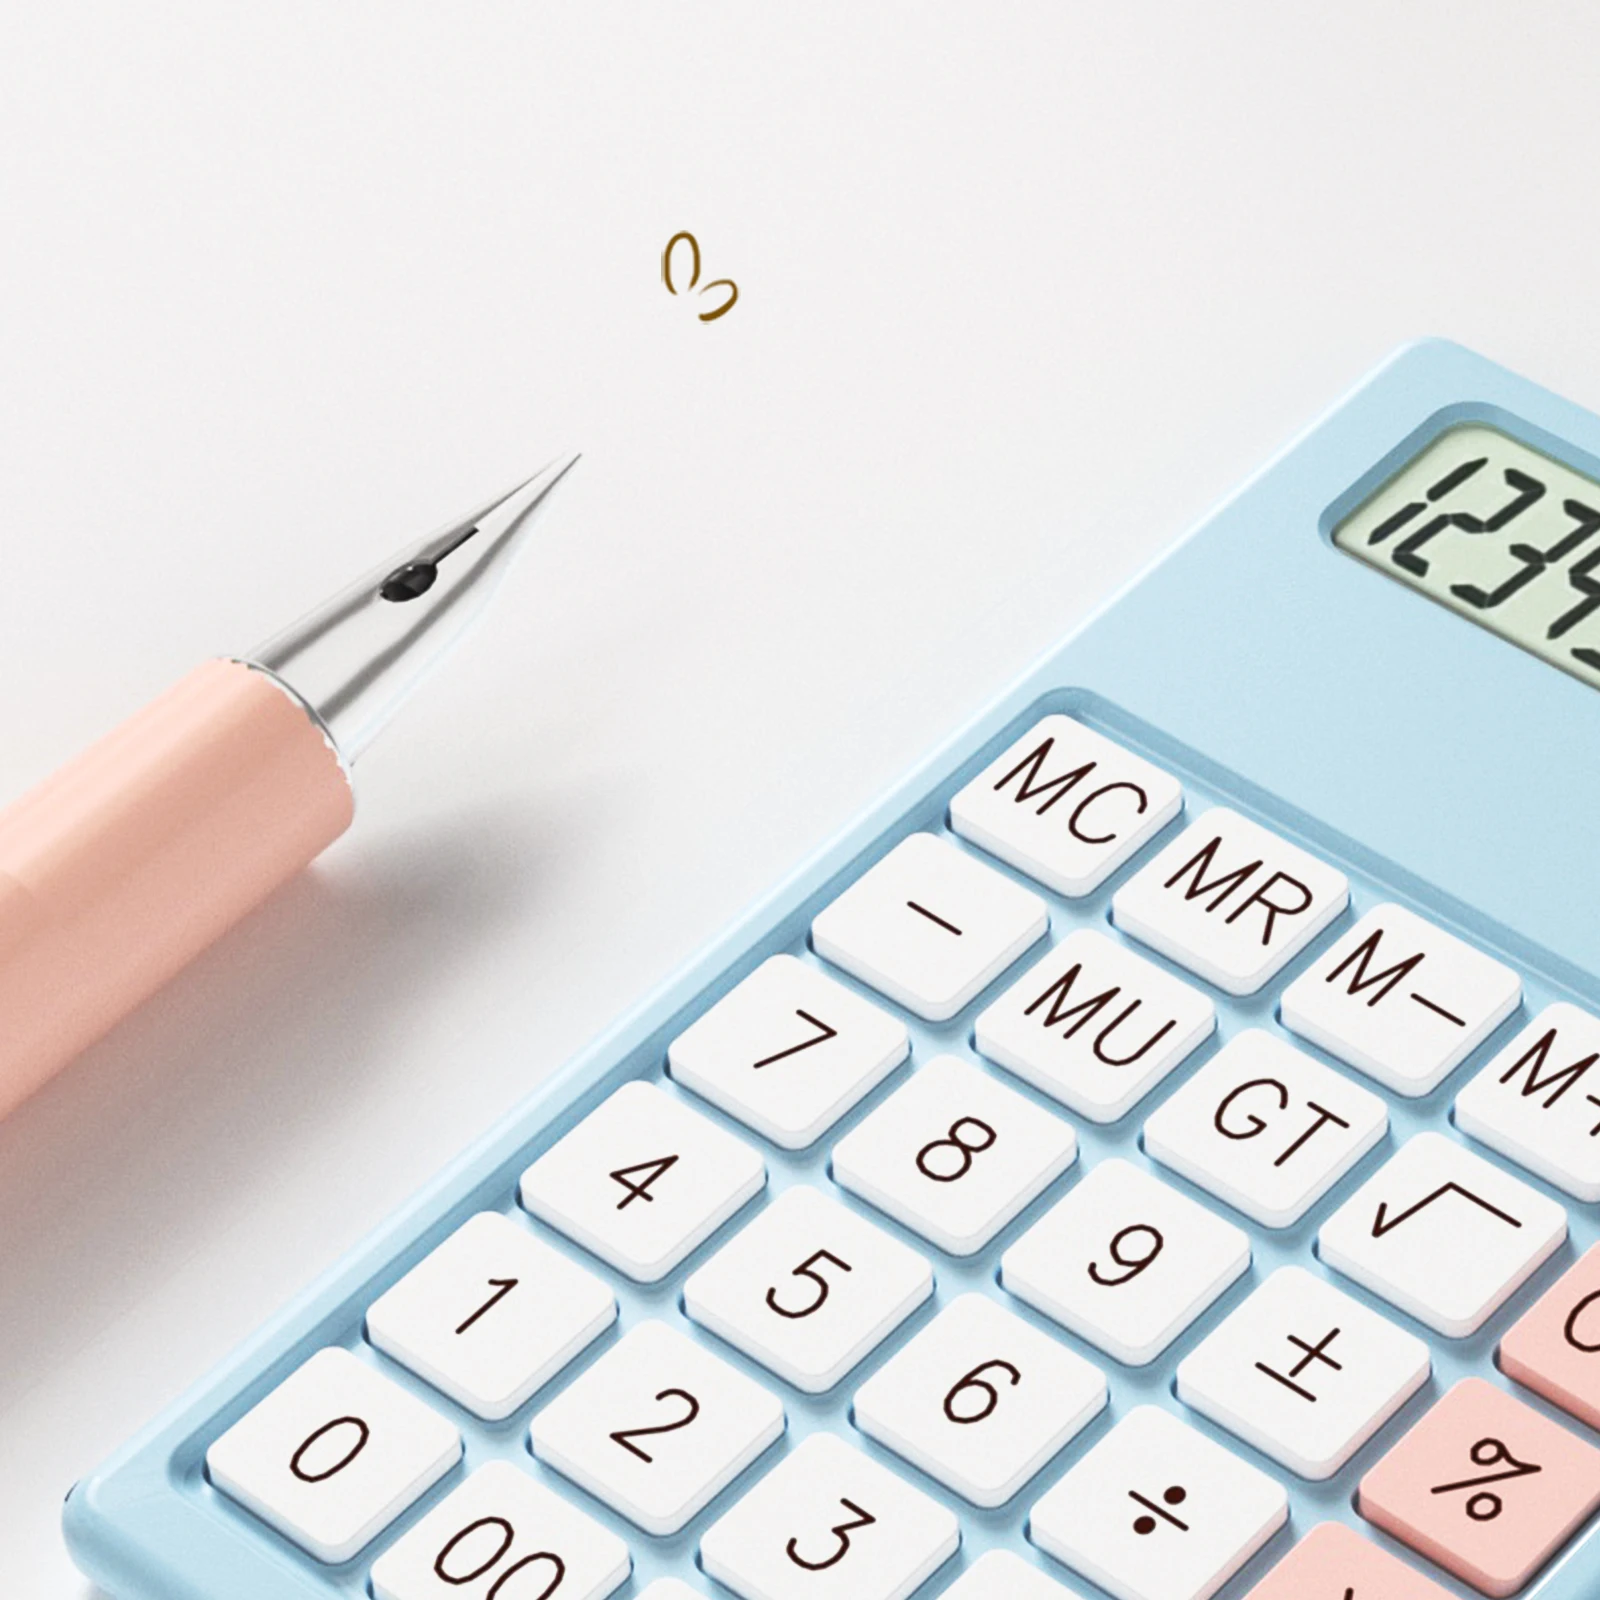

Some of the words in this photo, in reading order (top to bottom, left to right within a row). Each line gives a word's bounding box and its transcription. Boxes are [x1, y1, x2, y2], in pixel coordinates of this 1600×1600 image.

[993, 737, 1148, 844] MC
[1164, 836, 1313, 946] MR
[753, 1009, 838, 1069] 7
[1024, 963, 1177, 1067] MU
[1499, 1028, 1600, 1137] M
[915, 1116, 997, 1182] 8
[1214, 1078, 1350, 1167] GT
[609, 1155, 679, 1210] 4
[765, 1249, 852, 1319] 5
[1087, 1224, 1163, 1287] 9
[455, 1278, 519, 1335] 1
[609, 1388, 700, 1463] 2
[943, 1359, 1021, 1424] 6
[289, 1416, 370, 1483] 0
[1431, 1438, 1542, 1521] %
[434, 1516, 566, 1600] 00
[786, 1498, 876, 1571] 3
